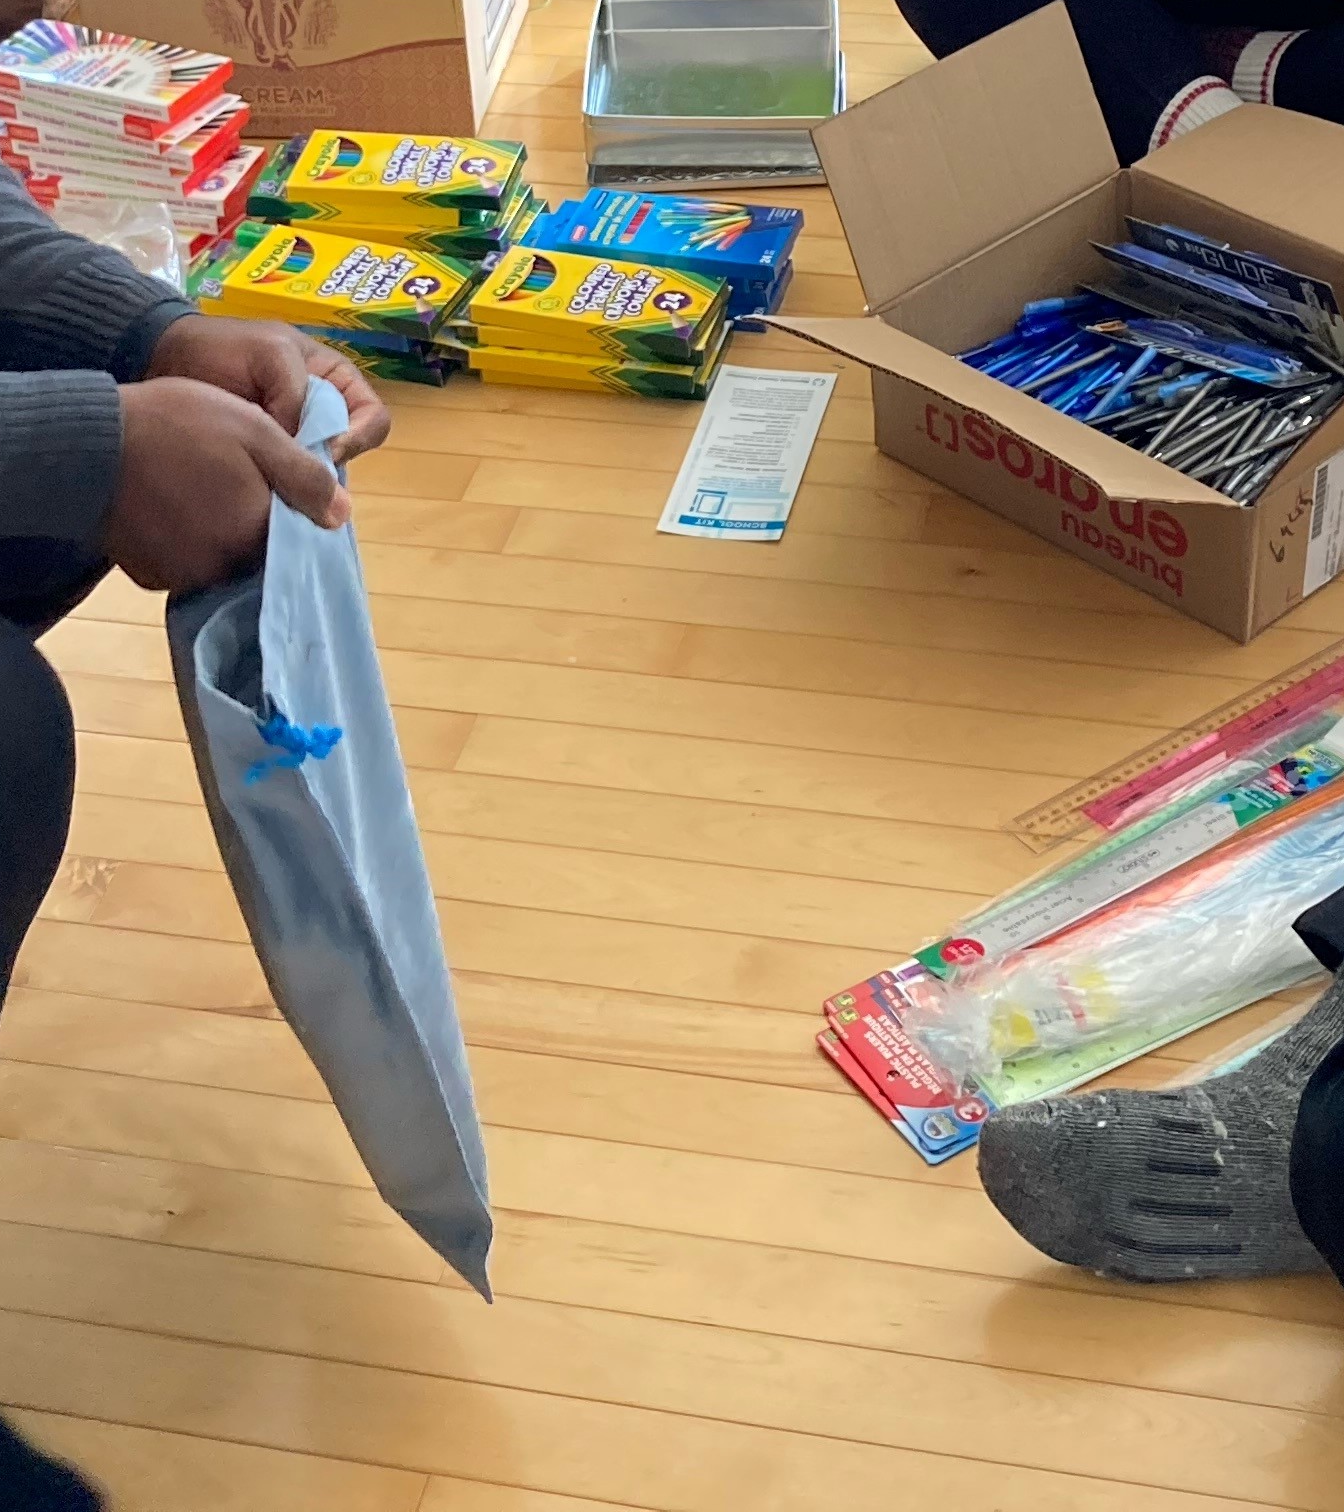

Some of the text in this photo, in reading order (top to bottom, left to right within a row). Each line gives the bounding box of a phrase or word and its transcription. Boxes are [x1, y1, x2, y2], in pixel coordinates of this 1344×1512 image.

[240, 86, 325, 104] CREAM
[306, 136, 340, 178] Crayola
[467, 157, 491, 175] 24
[246, 237, 297, 281] Crayola
[317, 245, 371, 297] COLOURED
[335, 255, 381, 295] PENCILS
[493, 255, 536, 298] Crayola
[1201, 248, 1275, 285] GLIDE
[352, 262, 396, 304] CRAYONS
[409, 278, 435, 295] 24
[567, 263, 613, 315] COLOURED
[585, 271, 626, 311] PENCILS
[603, 276, 646, 321] CRAYONS
[661, 292, 686, 311] 24
[695, 518, 768, 529] SCHOOL KIT
[1108, 500, 1188, 558] en
[1061, 510, 1185, 598] bureau
[862, 1014, 902, 1055] PLASTIQUE
[864, 1030, 922, 1089] PLASTIC RULERS
[900, 1053, 915, 1068] EN
[958, 1100, 983, 1120] 3
